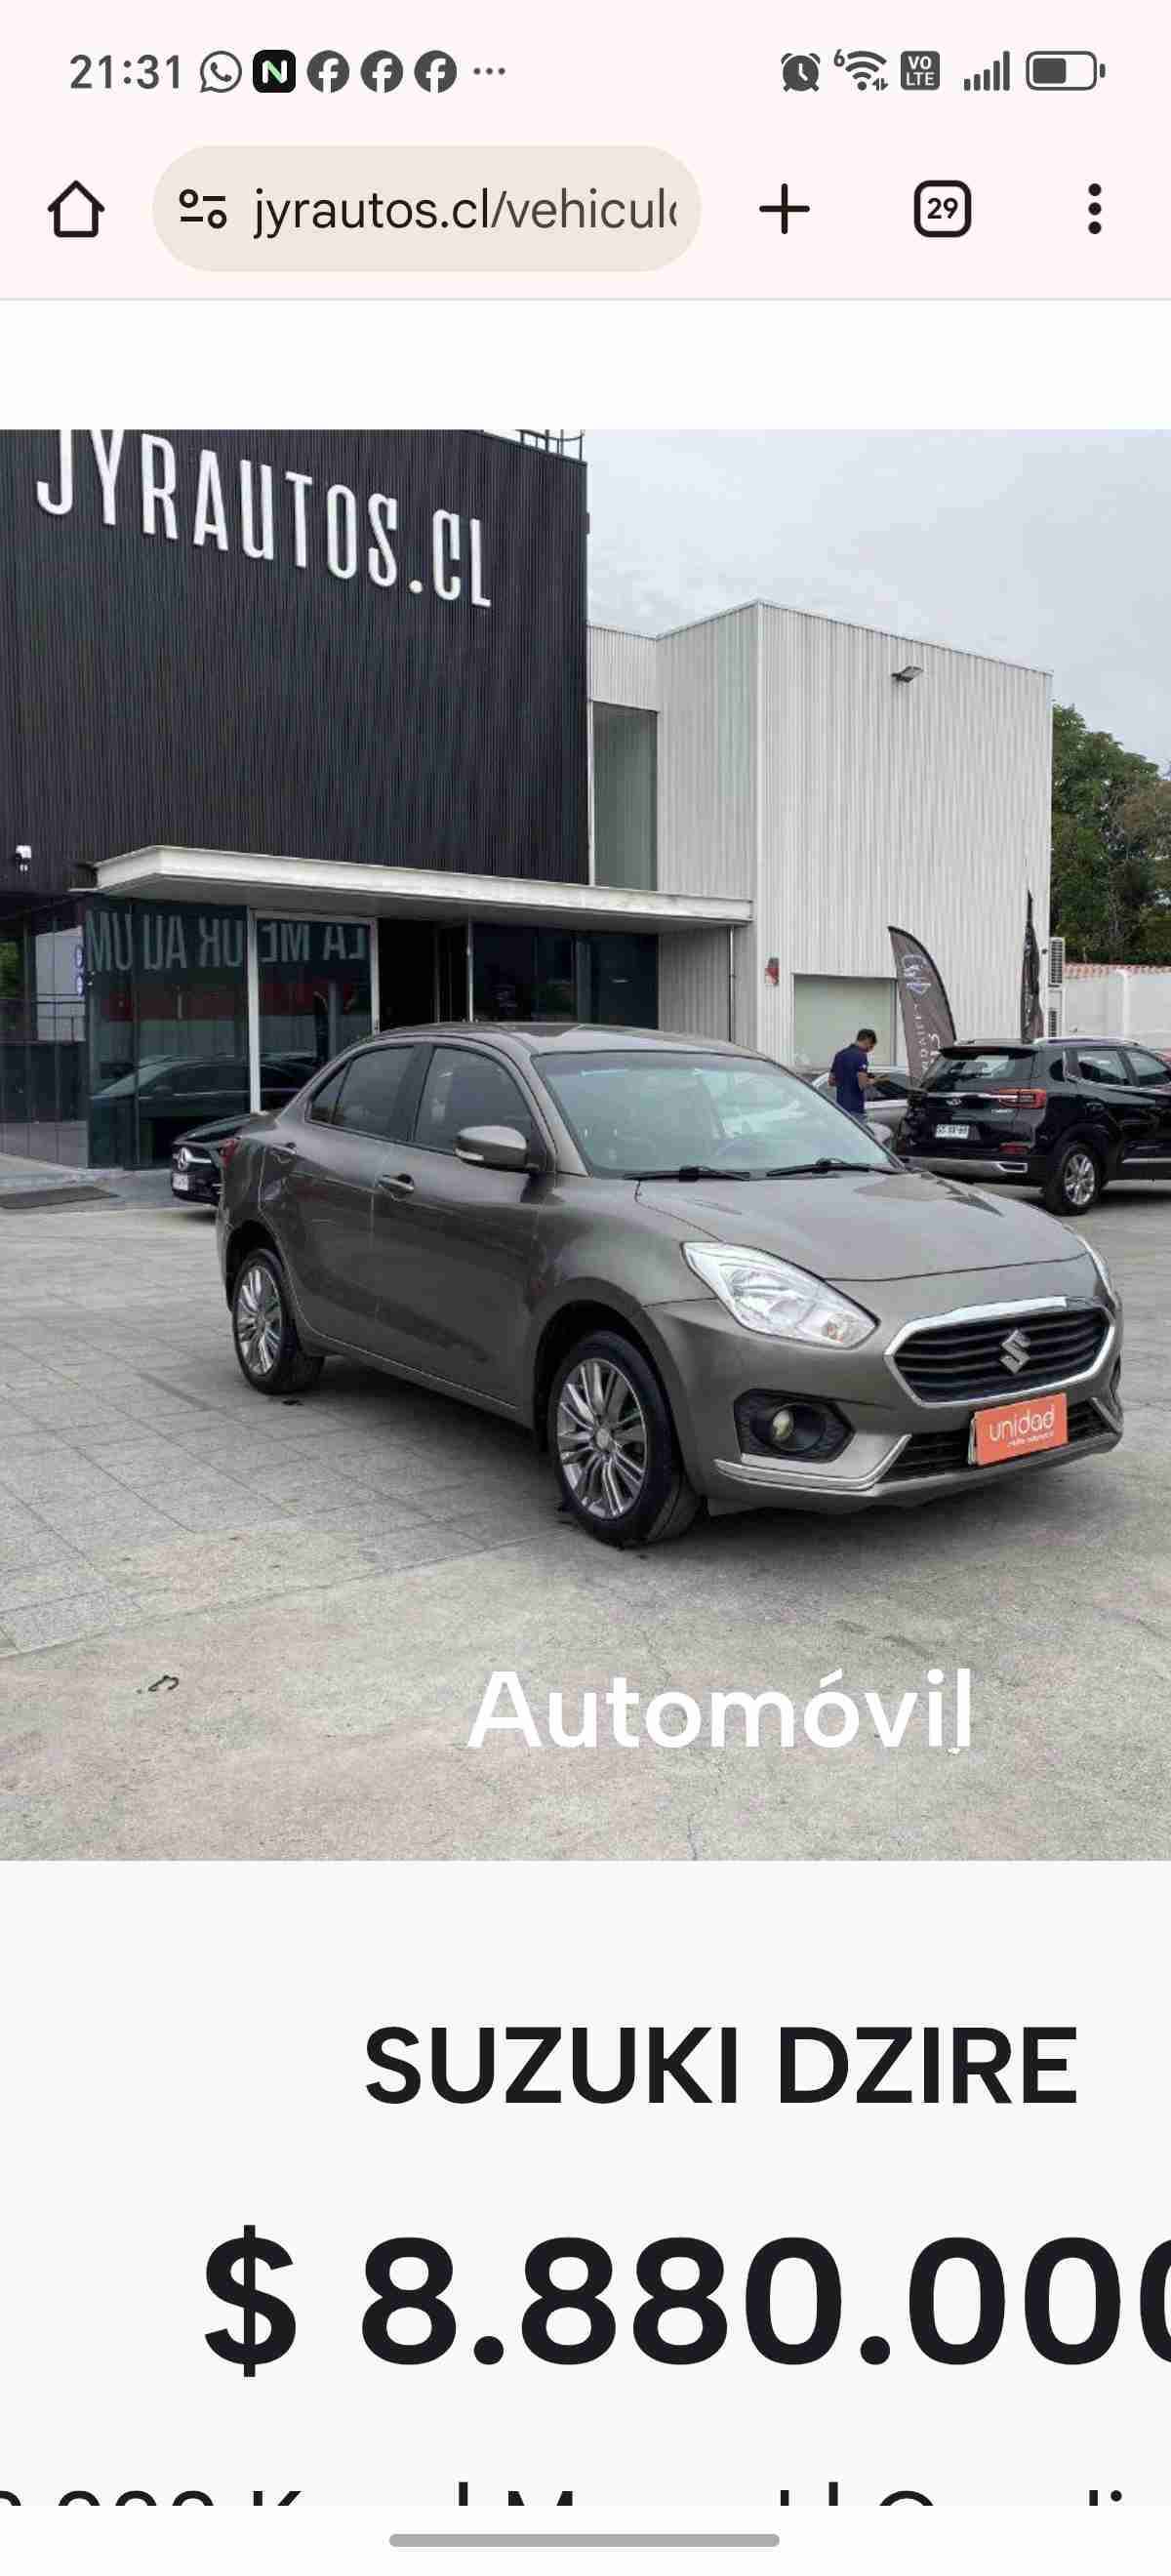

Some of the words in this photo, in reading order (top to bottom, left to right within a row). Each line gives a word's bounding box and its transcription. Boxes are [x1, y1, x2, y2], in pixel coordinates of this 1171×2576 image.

[69, 54, 180, 90] 21:31
[906, 72, 936, 87] LTE
[908, 56, 933, 71] VO
[927, 197, 959, 221] 29
[36, 429, 492, 607] JYRAUTOS.CL
[989, 1404, 1055, 1441] unidad
[366, 2026, 737, 2105] SUZUKI
[780, 2026, 1077, 2105] DZIRE
[204, 2224, 297, 2378] $
